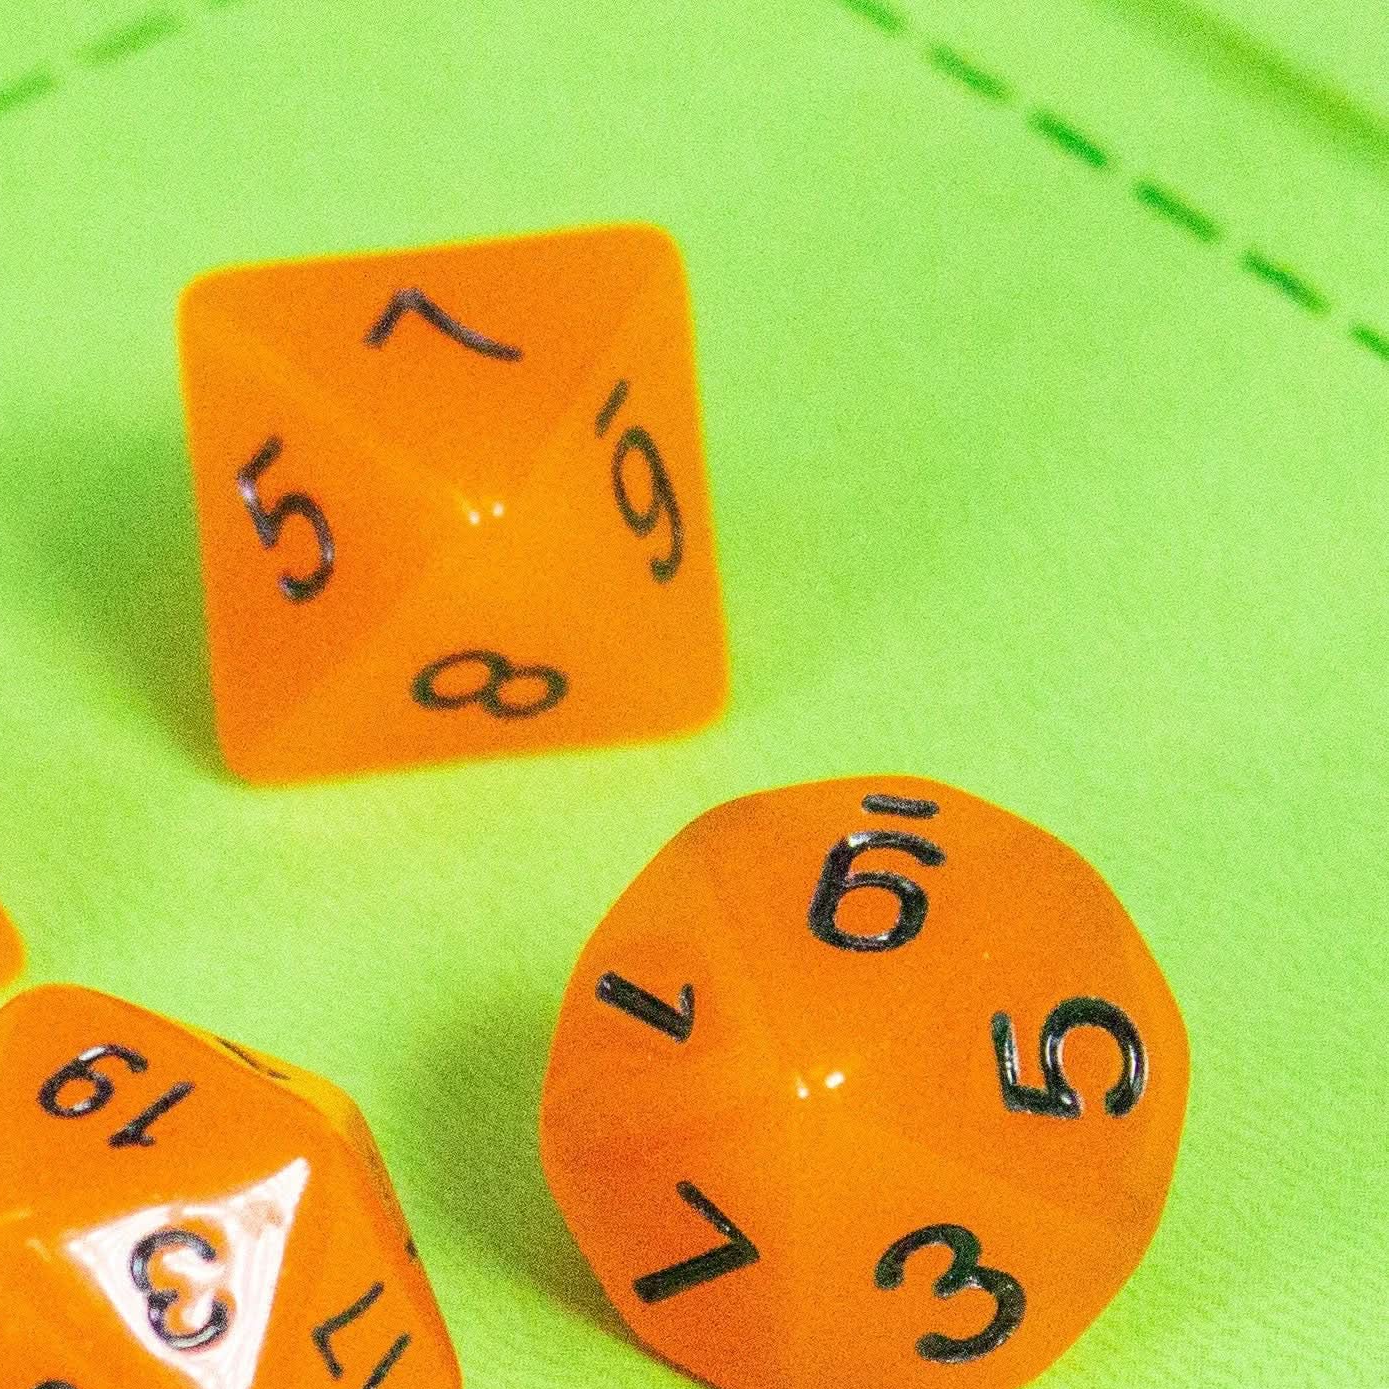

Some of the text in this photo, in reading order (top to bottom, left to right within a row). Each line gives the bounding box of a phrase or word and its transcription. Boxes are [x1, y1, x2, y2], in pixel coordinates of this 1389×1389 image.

[363, 286, 523, 364] 7
[233, 433, 335, 604] 5
[410, 649, 569, 721] 8
[595, 970, 695, 1044] 1
[991, 996, 1149, 1119] 5
[37, 1044, 195, 1149] 19
[129, 1229, 229, 1352] 3
[631, 1180, 760, 1304] 7
[873, 1223, 1027, 1365] 3
